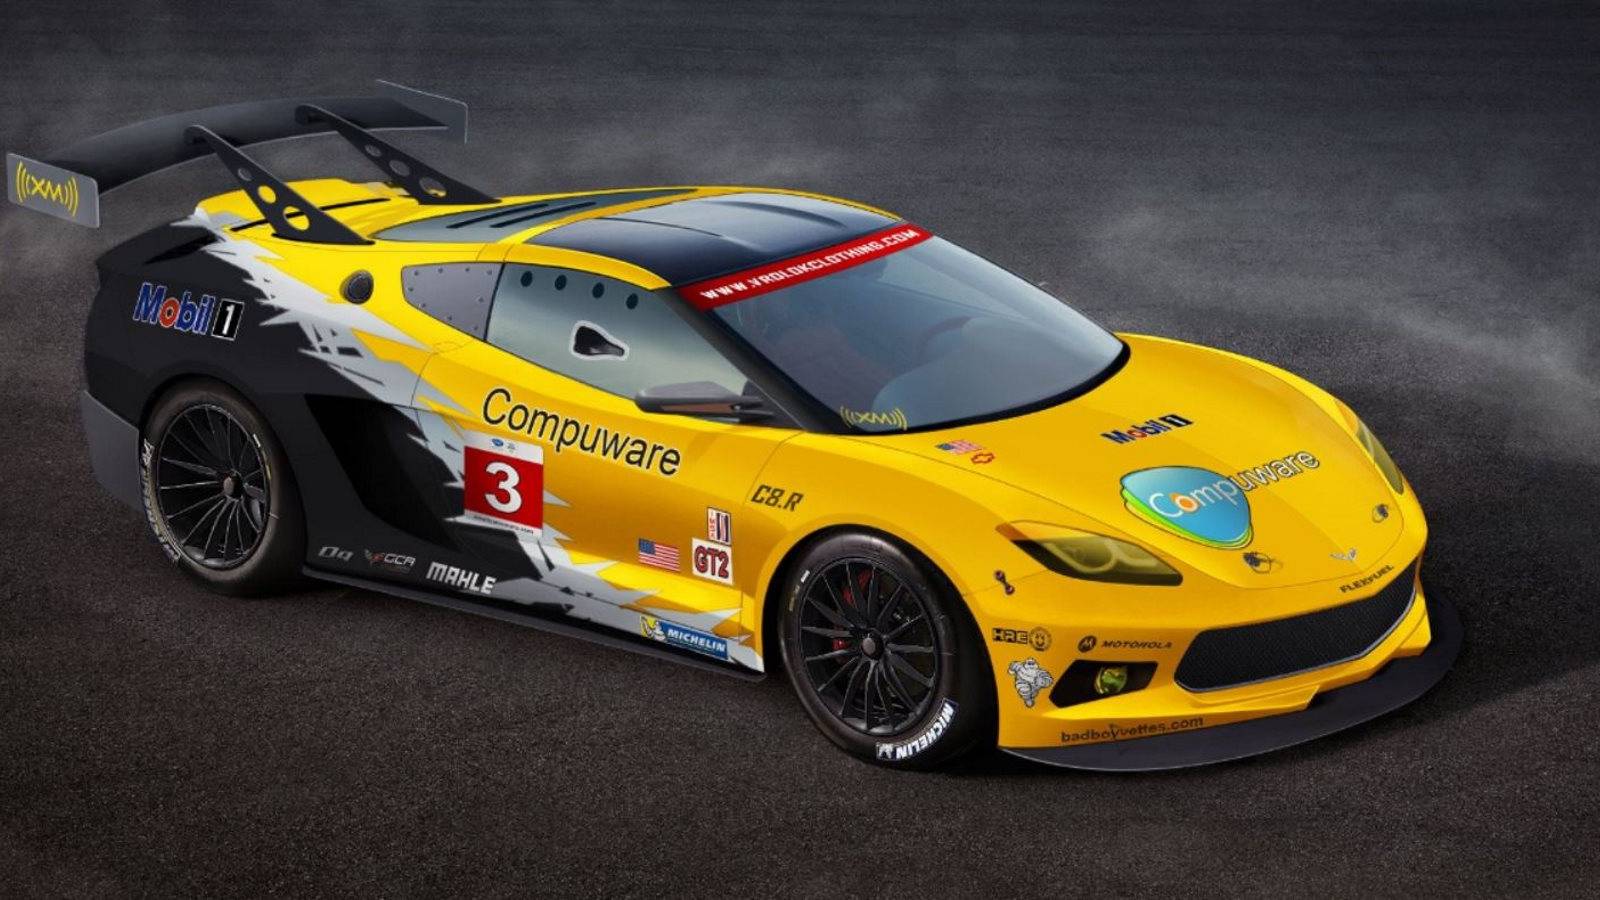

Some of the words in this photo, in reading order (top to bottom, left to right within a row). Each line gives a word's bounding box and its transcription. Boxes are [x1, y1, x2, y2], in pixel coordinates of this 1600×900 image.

[133, 282, 215, 335] Mobil
[483, 388, 681, 475] Compuware
[1101, 419, 1171, 444] Mobil
[485, 461, 522, 514] 3
[751, 484, 804, 512] C8.R
[1148, 451, 1320, 518] Compuware
[425, 561, 497, 595] MAHLE
[694, 545, 729, 579] GT2
[1338, 564, 1395, 594] FLEXFUEL
[667, 629, 727, 652] MICHELIN
[992, 627, 1028, 644] HRE
[896, 702, 955, 759] MICHELIN
[1061, 716, 1204, 743] badboyvettes.com
